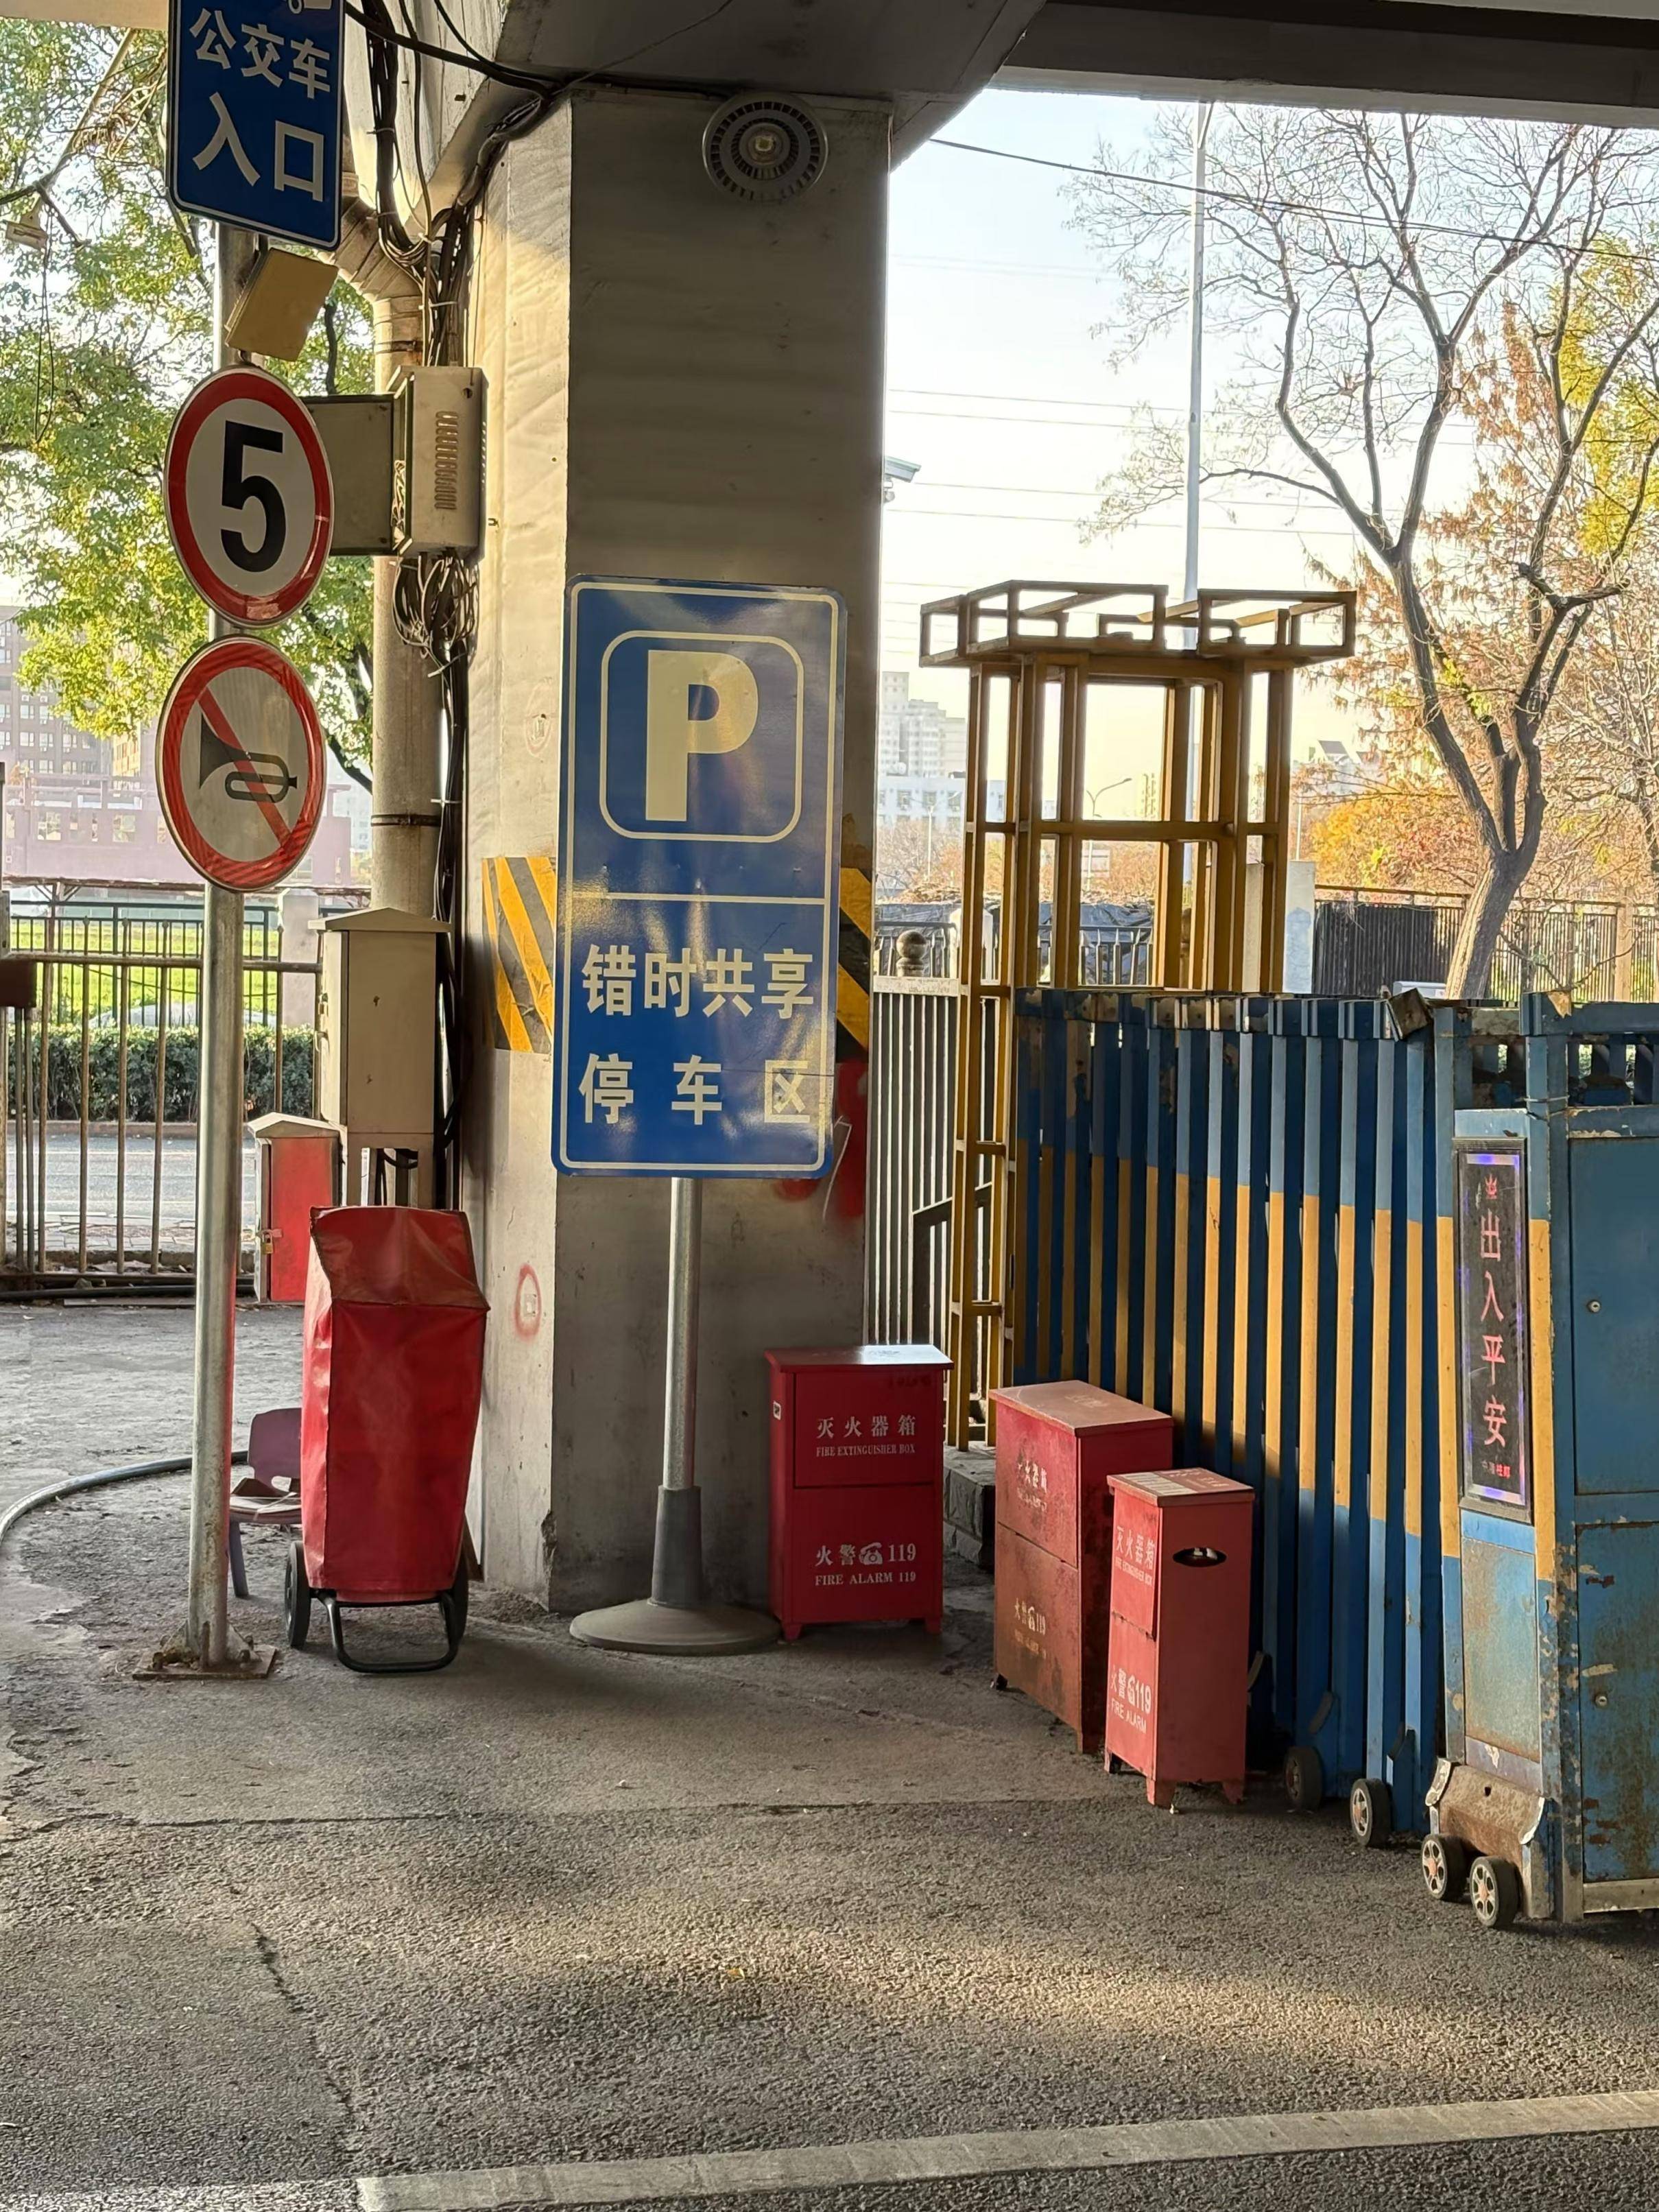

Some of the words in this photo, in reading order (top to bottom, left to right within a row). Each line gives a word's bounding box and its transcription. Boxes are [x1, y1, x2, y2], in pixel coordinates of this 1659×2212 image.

[189, 8, 331, 99] 公交车
[192, 92, 324, 202] 入口
[220, 420, 287, 573] 5
[645, 649, 759, 822] P
[582, 944, 814, 1019] 错时共享
[578, 1053, 811, 1126] 停车区
[1479, 1207, 1507, 1447] 出入平安
[816, 1414, 916, 1439] 灭火器箱
[816, 1446, 835, 1458] FIRE
[837, 1444, 897, 1457] EXTINGUISHER
[899, 1443, 916, 1454] BOX
[815, 1545, 856, 1567] 火警
[889, 1543, 916, 1562] 119
[1116, 1525, 1156, 1571] 灭火器箱
[815, 1574, 844, 1586] FIRE
[850, 1572, 893, 1584] ALARM
[900, 1571, 916, 1582] 119
[1111, 1697, 1125, 1720] FIRE
[1125, 1709, 1147, 1735] ALARM
[1135, 1678, 1151, 1715] 119
